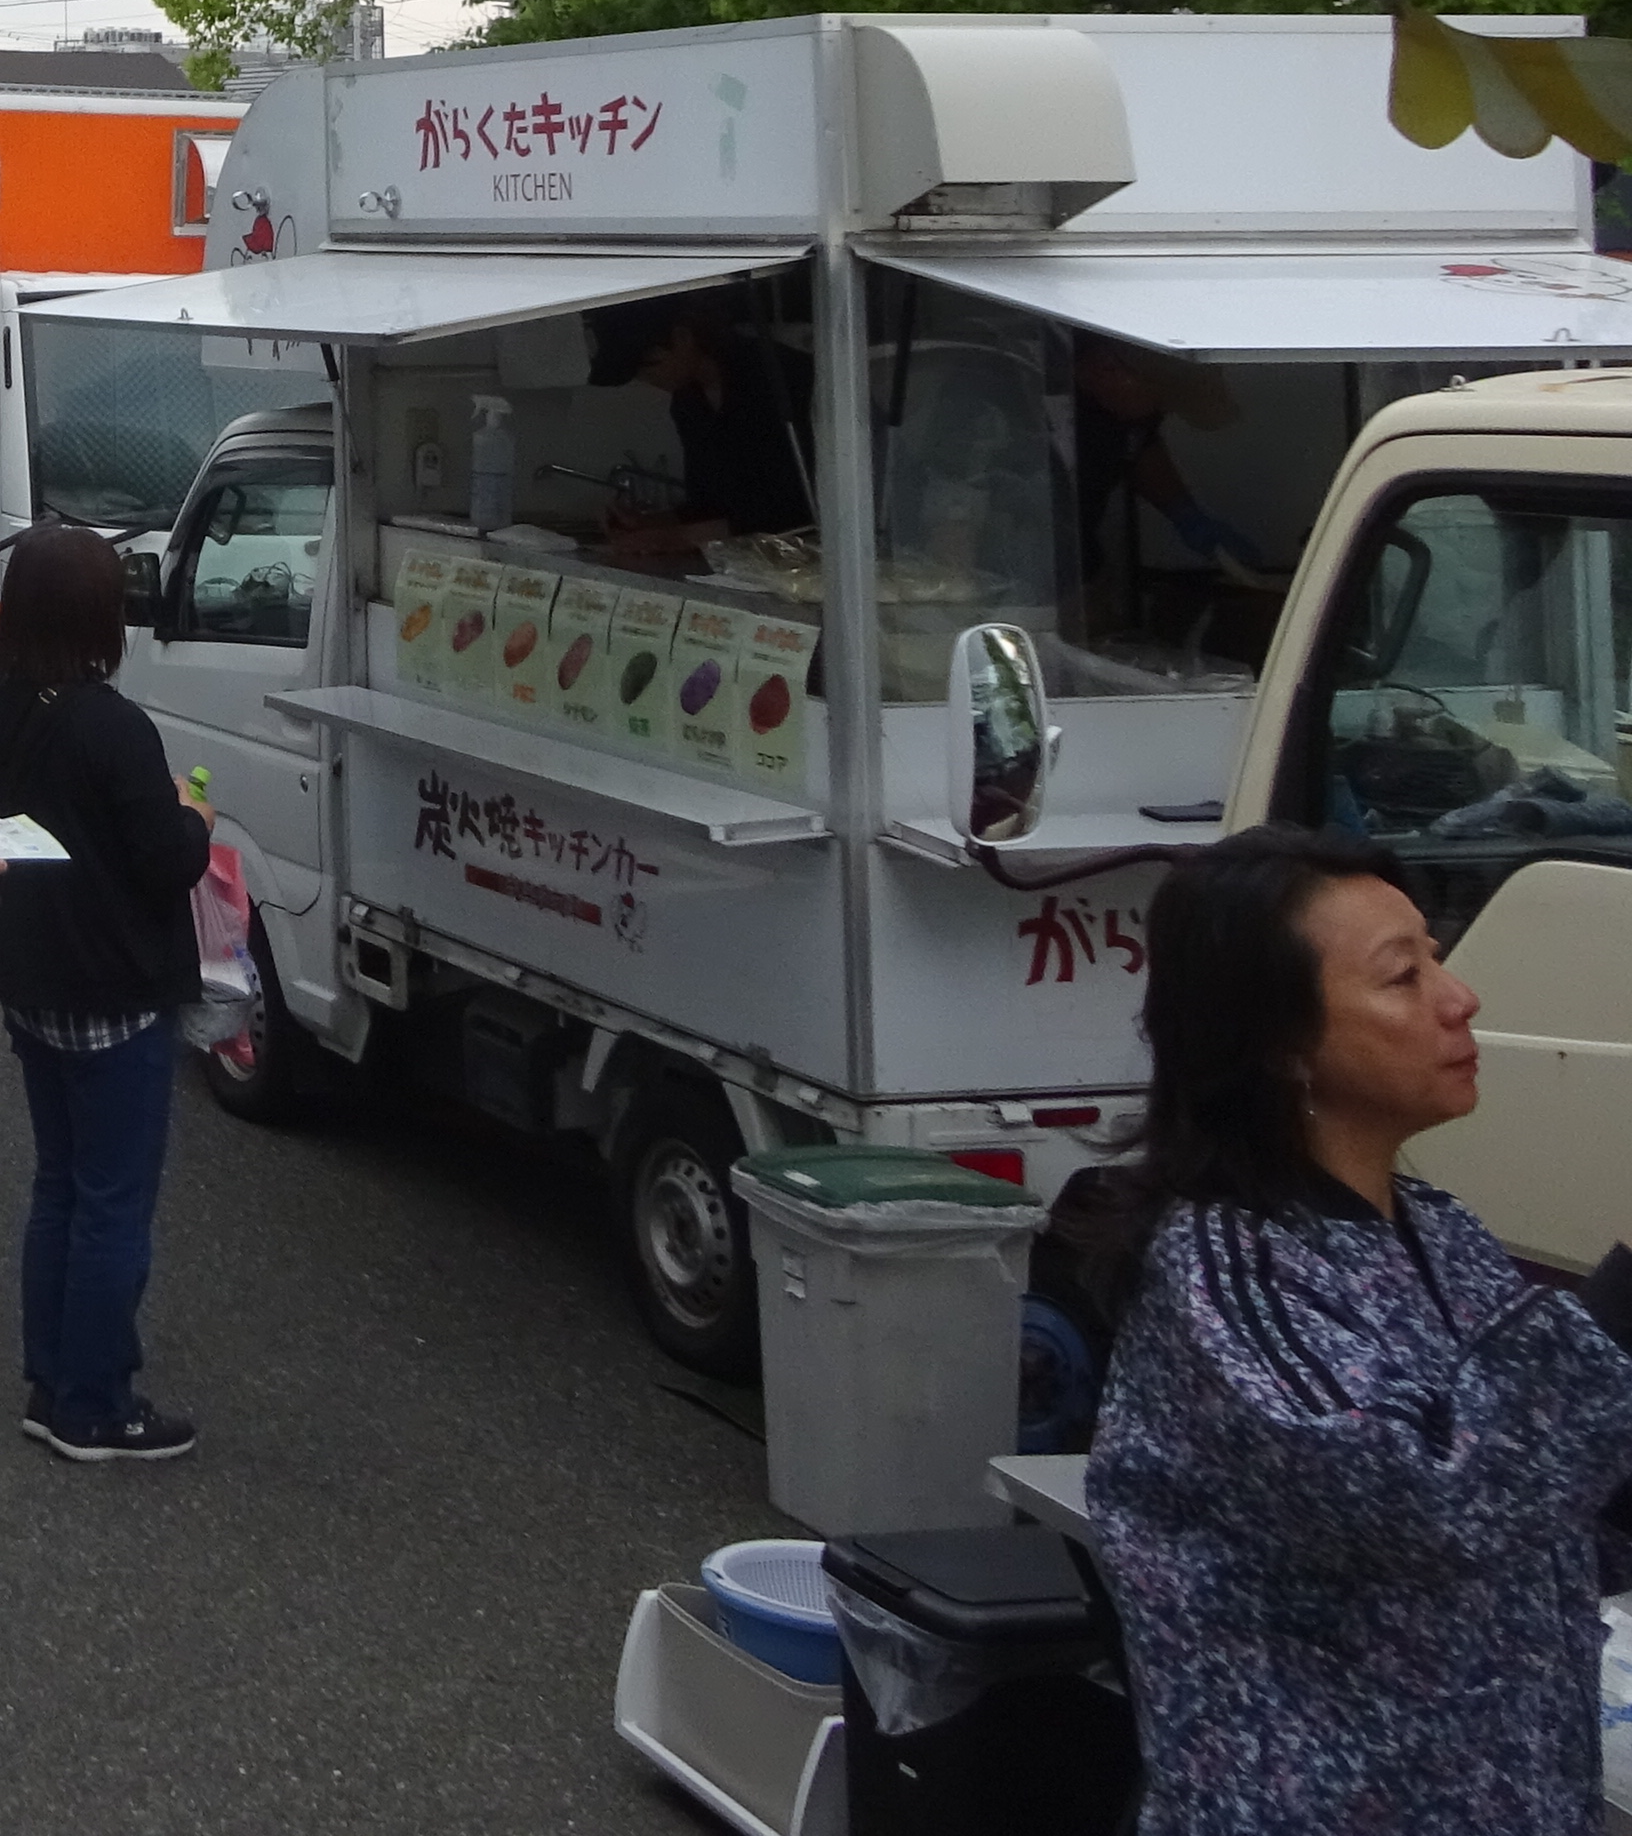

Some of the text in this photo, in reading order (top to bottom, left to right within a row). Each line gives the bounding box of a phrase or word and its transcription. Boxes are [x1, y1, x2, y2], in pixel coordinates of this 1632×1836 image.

[415, 91, 663, 172] がらくたキッチン
[492, 172, 573, 203] KITCHEN
[414, 768, 661, 886] 炭火焼キッチンカー
[1018, 895, 1145, 986] がら
